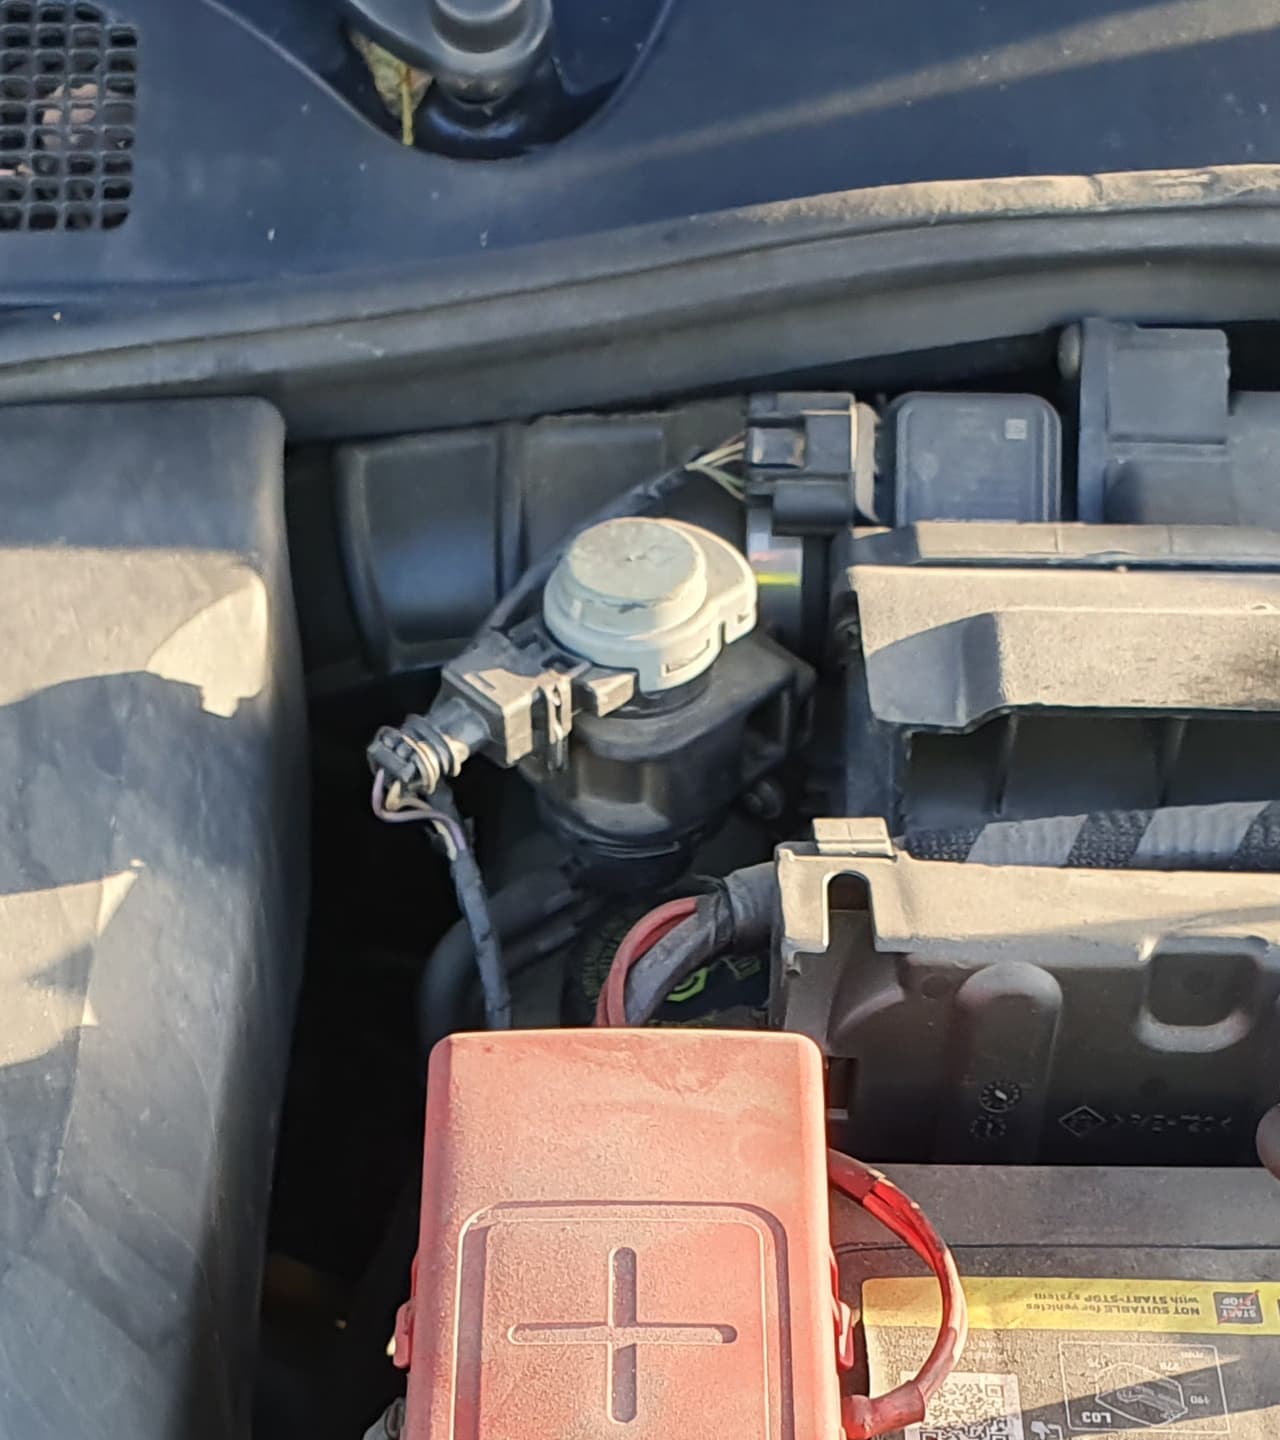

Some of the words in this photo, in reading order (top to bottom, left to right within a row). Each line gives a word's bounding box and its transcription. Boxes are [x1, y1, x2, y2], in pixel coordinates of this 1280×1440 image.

[1033, 1291, 1081, 1302] system
[1084, 1293, 1169, 1305] START-STOP
[1171, 1295, 1200, 1306] with
[1025, 1302, 1079, 1313] vehicles
[1081, 1303, 1102, 1314] for
[1104, 1304, 1170, 1315] SUITABLE
[1174, 1305, 1201, 1316] NOT
[1081, 1411, 1112, 1424] L03
